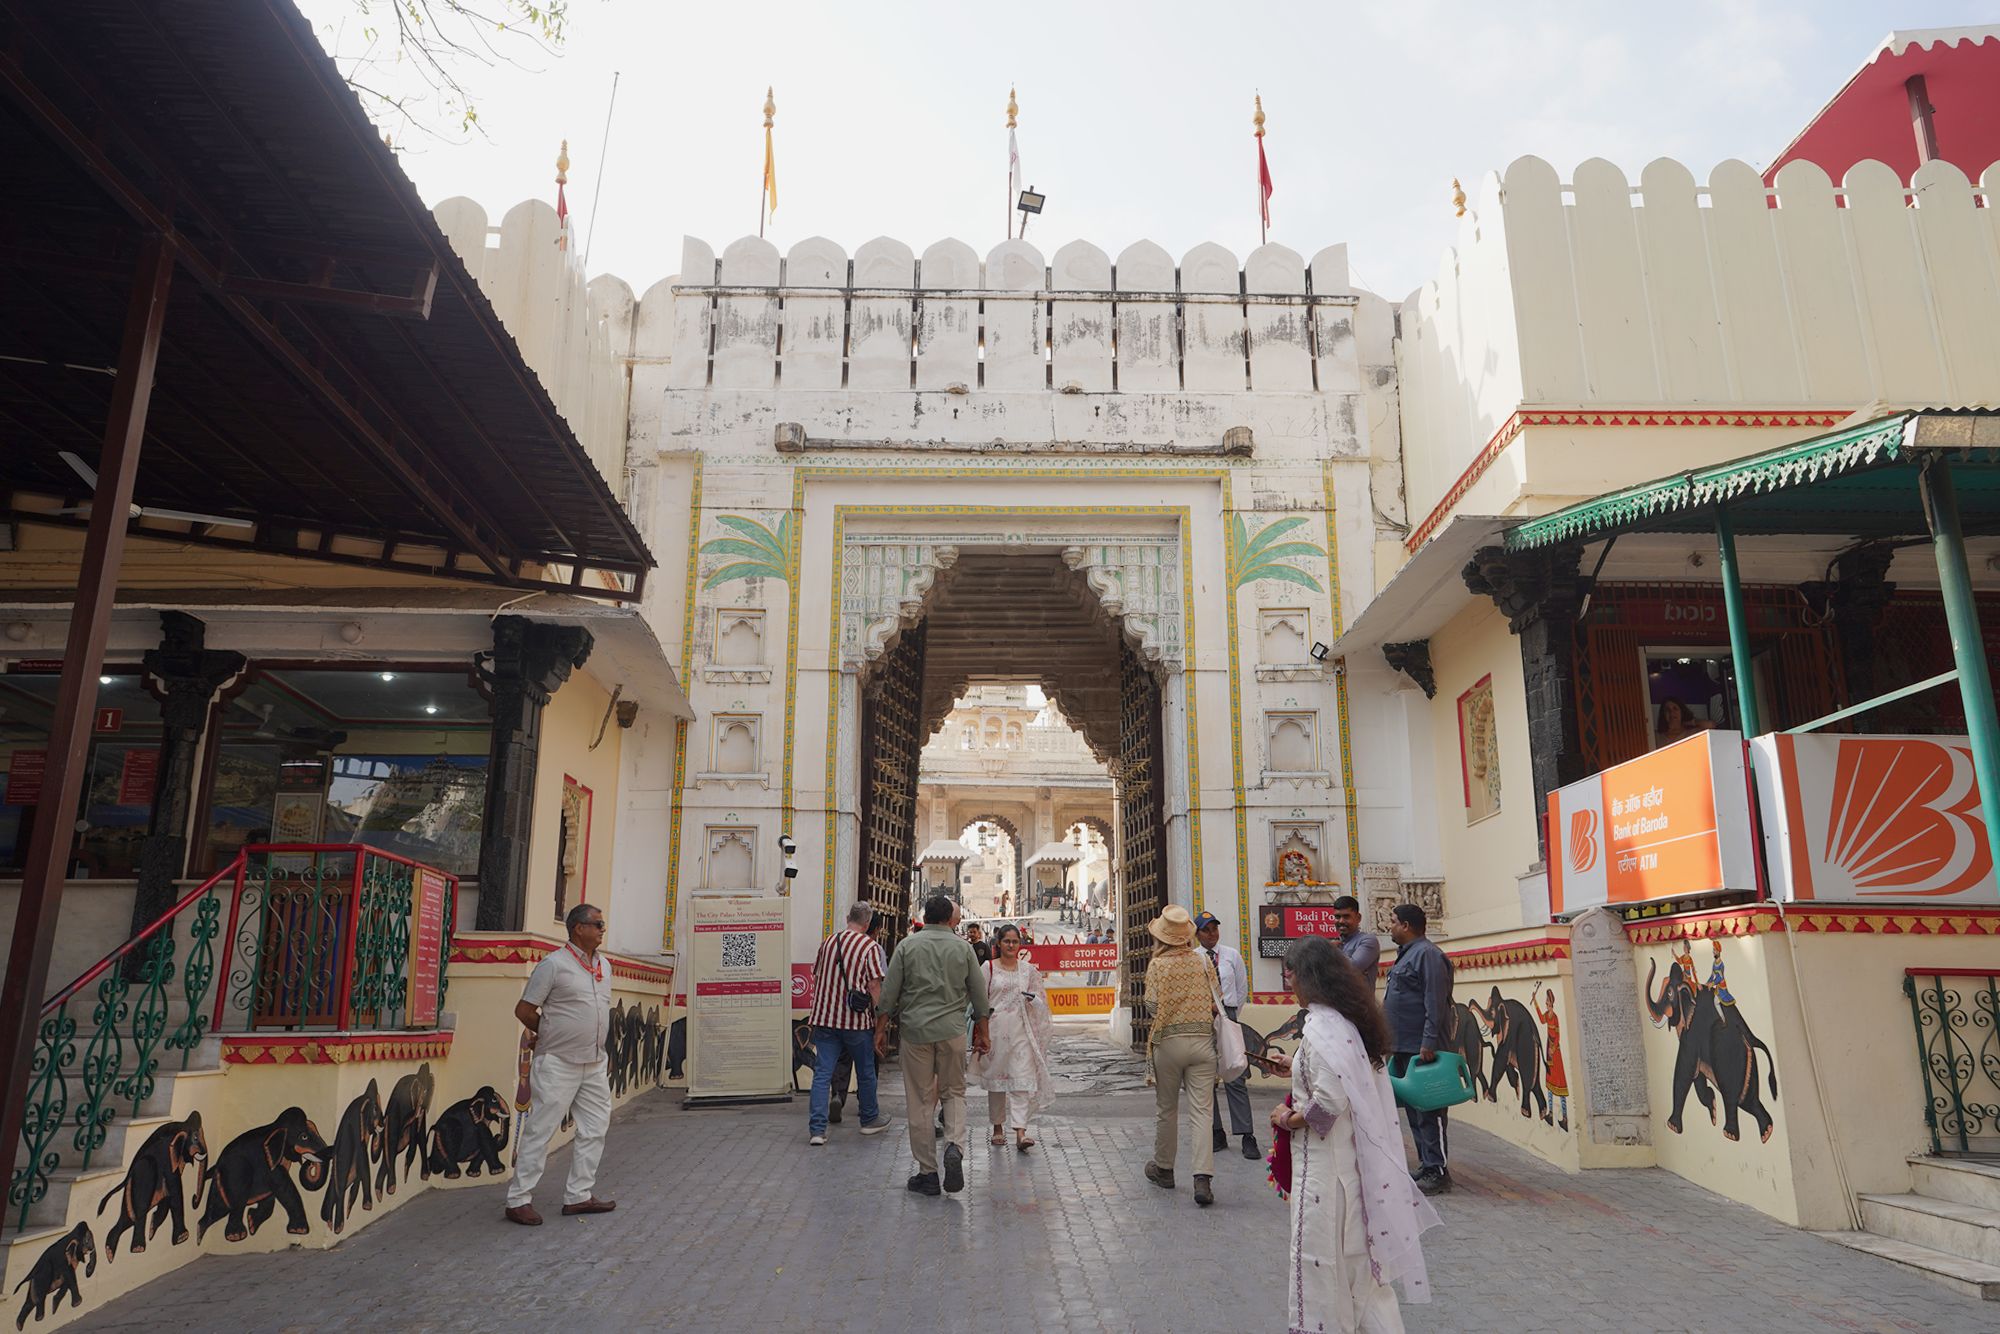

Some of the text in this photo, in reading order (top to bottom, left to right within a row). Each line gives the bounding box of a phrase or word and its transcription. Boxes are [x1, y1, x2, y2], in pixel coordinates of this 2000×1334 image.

[104, 712, 114, 728] 1
[1614, 812, 1668, 841] Bank of Baroda
[1618, 854, 1638, 874] एटीएम
[1640, 853, 1658, 871] ATM
[707, 911, 719, 920] City
[1295, 910, 1336, 921] Badi Po
[1318, 921, 1337, 933] पोल
[1074, 949, 1116, 957] STOP FOR
[1059, 960, 1100, 968] SECURITY
[1051, 994, 1080, 1007] YOUR
